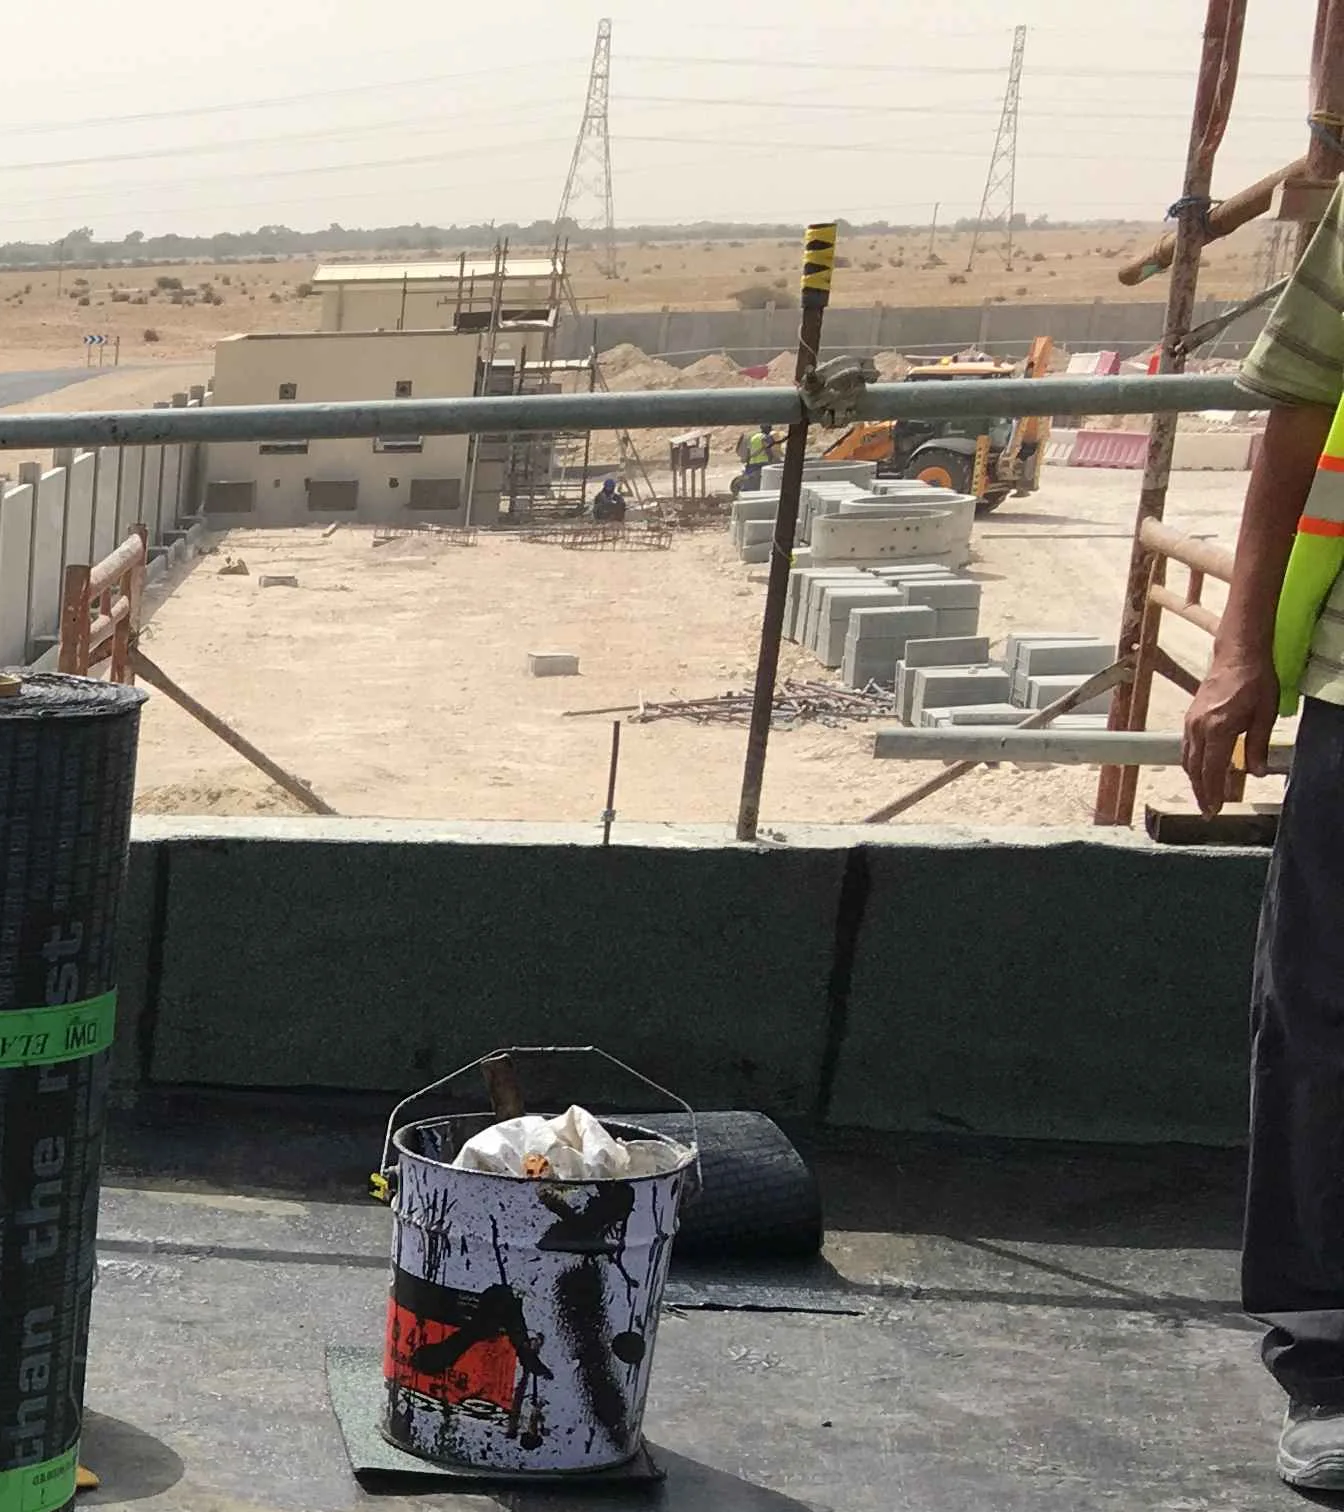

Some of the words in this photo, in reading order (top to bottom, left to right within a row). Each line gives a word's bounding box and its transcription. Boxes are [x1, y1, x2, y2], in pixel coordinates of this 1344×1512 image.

[31, 920, 84, 1094] rst
[15, 1134, 68, 1264] the
[5, 1302, 58, 1461] than
